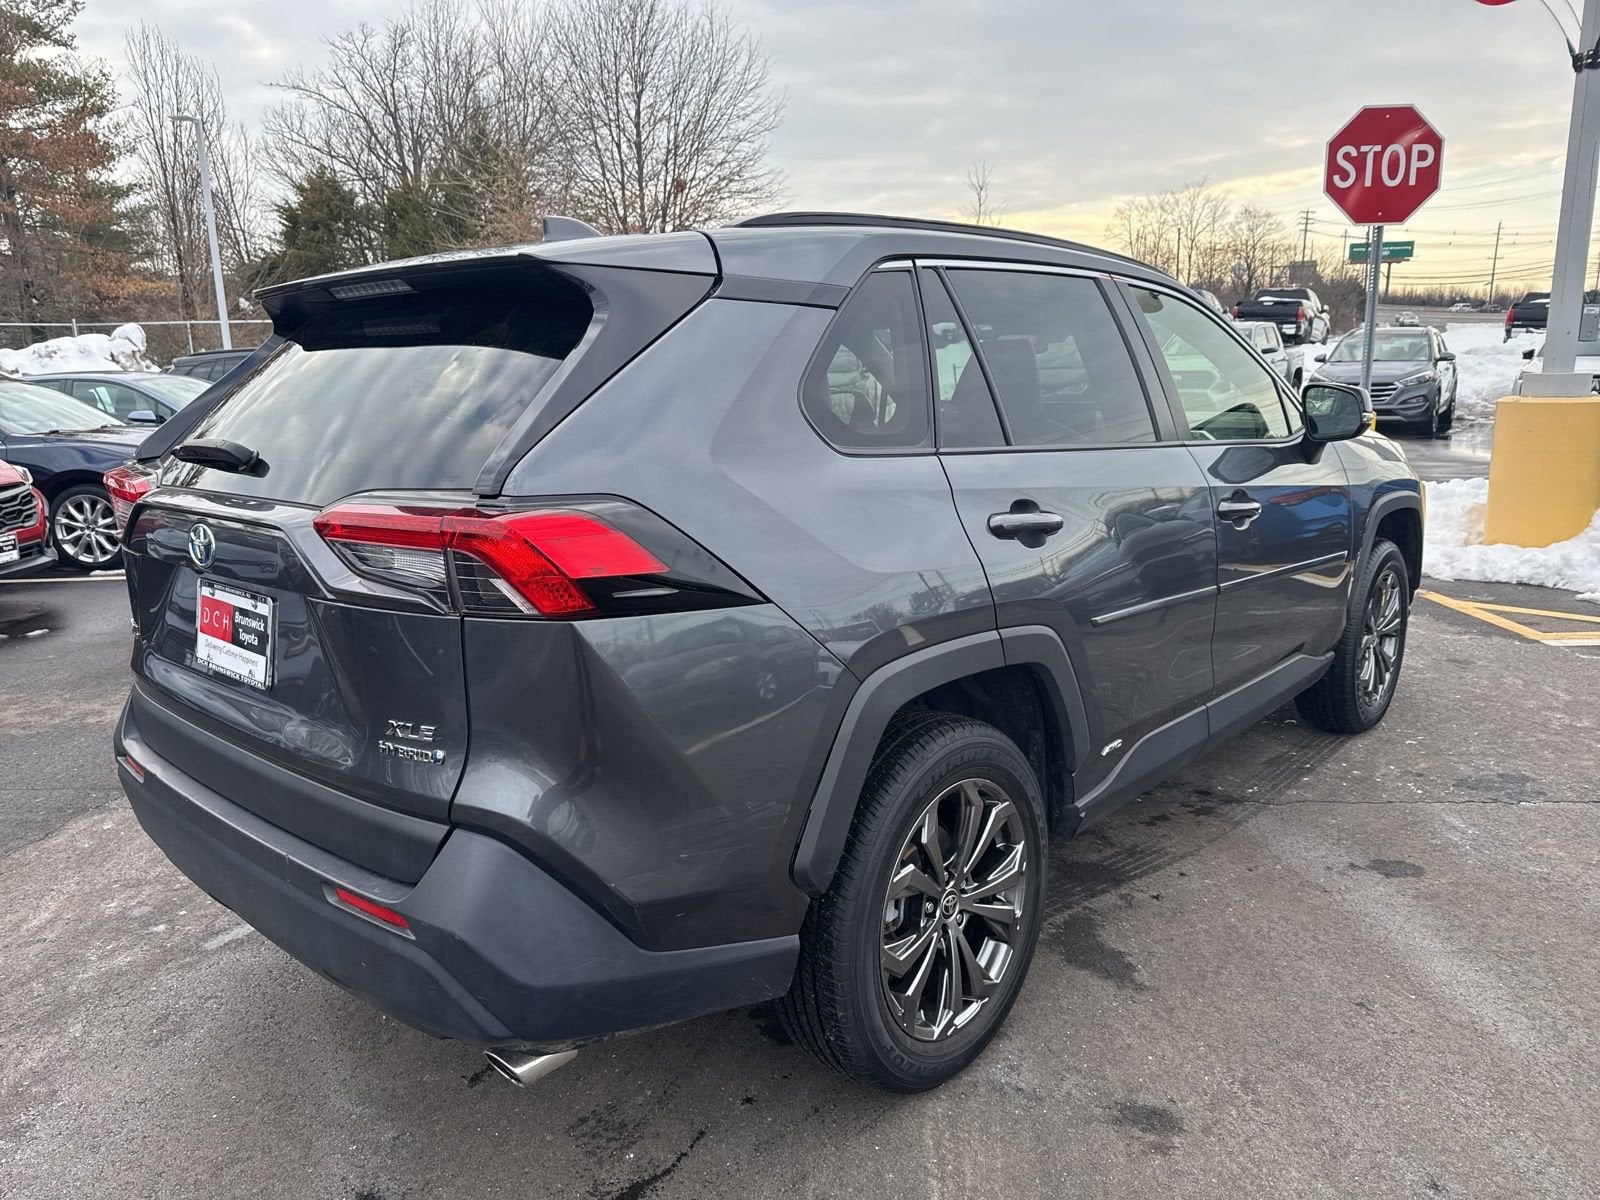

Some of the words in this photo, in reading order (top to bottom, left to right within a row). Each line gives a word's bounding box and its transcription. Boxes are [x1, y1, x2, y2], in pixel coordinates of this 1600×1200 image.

[1333, 143, 1435, 189] STOP
[203, 606, 230, 631] DCH
[234, 611, 265, 632] Brunswick
[239, 628, 259, 646] Toyota
[197, 658, 208, 667] DCH
[209, 662, 240, 680] BRUNSWICK
[240, 675, 264, 690] TOYOTA
[386, 720, 436, 742] XLE
[378, 740, 433, 763] HYBRID
